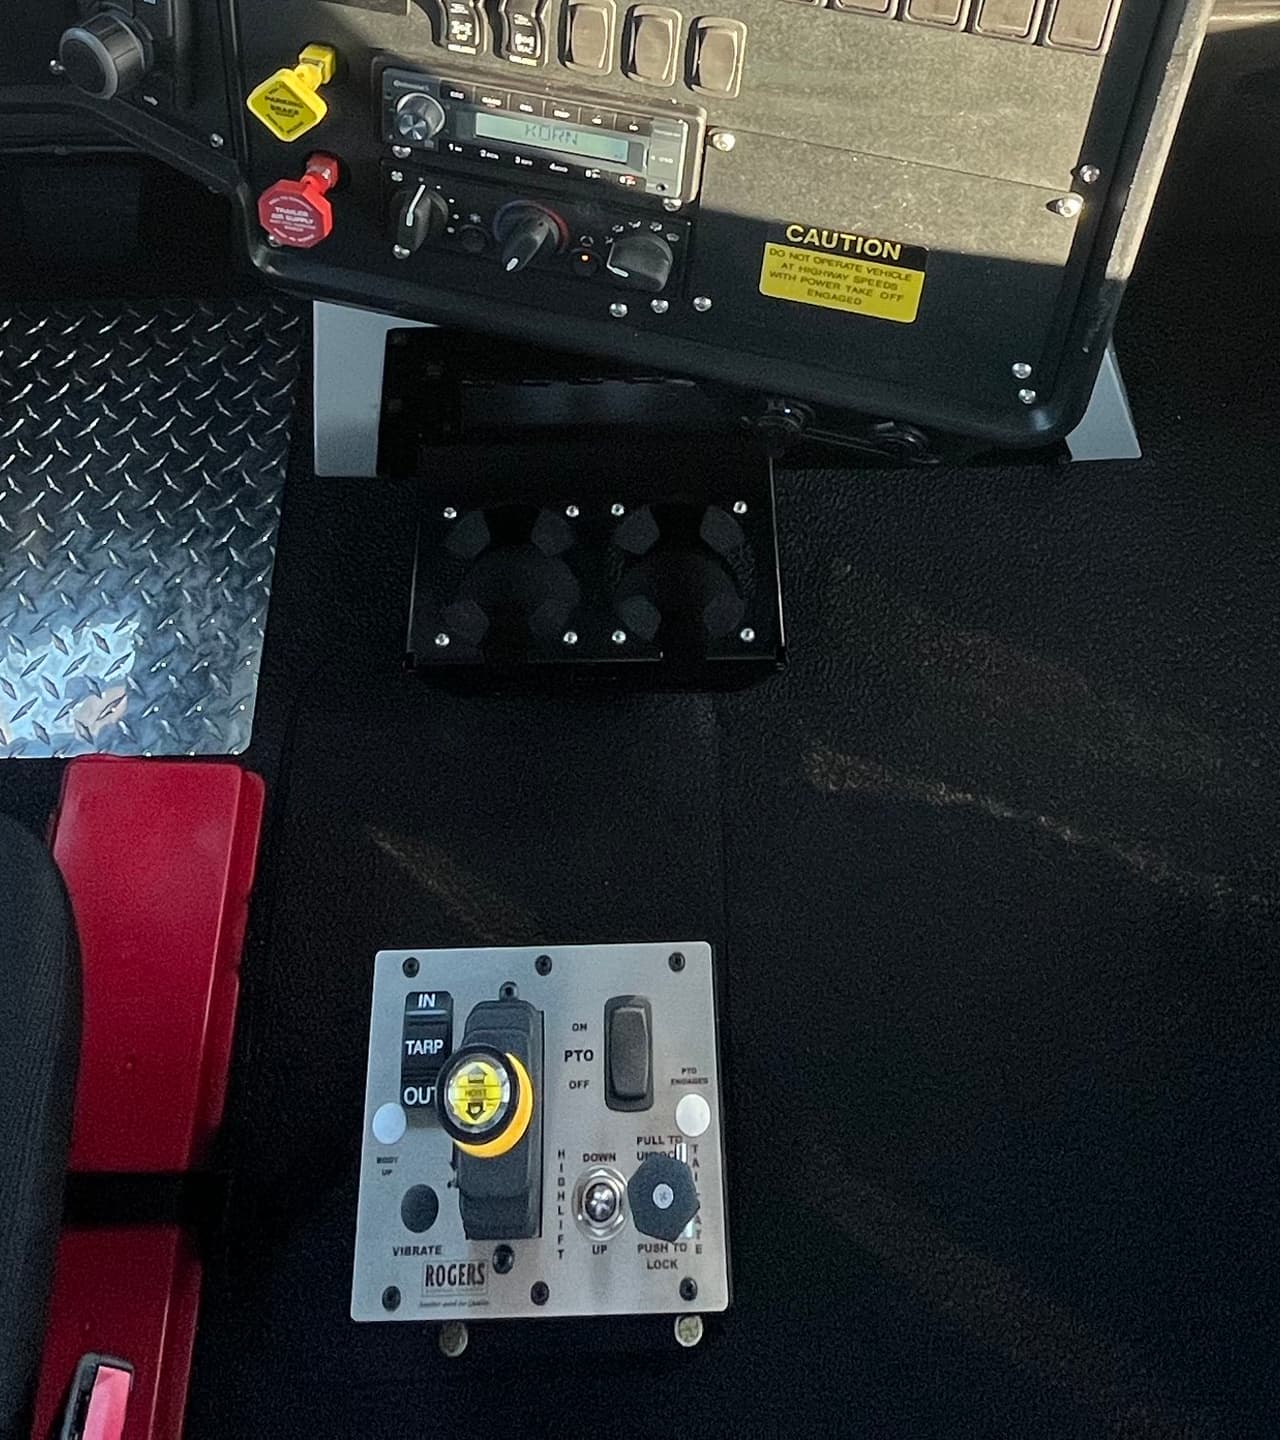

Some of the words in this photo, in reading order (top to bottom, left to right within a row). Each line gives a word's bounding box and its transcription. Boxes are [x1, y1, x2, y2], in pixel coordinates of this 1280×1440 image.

[524, 122, 579, 147] KORN
[275, 206, 309, 217] TRAILER
[785, 223, 902, 261] CAUTION
[769, 247, 786, 259] DO
[789, 253, 811, 264] NOT
[813, 256, 865, 273] OPERATE
[866, 267, 913, 282] VEHICLE
[780, 262, 795, 271] AT
[798, 265, 850, 281] HIGHWAY
[853, 275, 899, 291] SPEEDS
[769, 271, 797, 282] WITH
[800, 276, 841, 290] POWER
[845, 285, 874, 297] TAKE
[880, 292, 905, 303] OFF
[807, 288, 862, 306] ENGAGED
[417, 992, 437, 1009] IN
[404, 1039, 444, 1055] TARP
[564, 1049, 595, 1063] PTO
[681, 1066, 698, 1075] PTO
[568, 1079, 590, 1090] OFF
[637, 1135, 665, 1146] PULL
[582, 1152, 617, 1163] DOWN
[392, 1244, 443, 1257] VIBRATE
[592, 1244, 608, 1255] UP
[637, 1243, 669, 1254] PUSH
[673, 1242, 688, 1253] TO
[646, 1259, 679, 1270] LOCK
[425, 1262, 486, 1288] ROGERS
